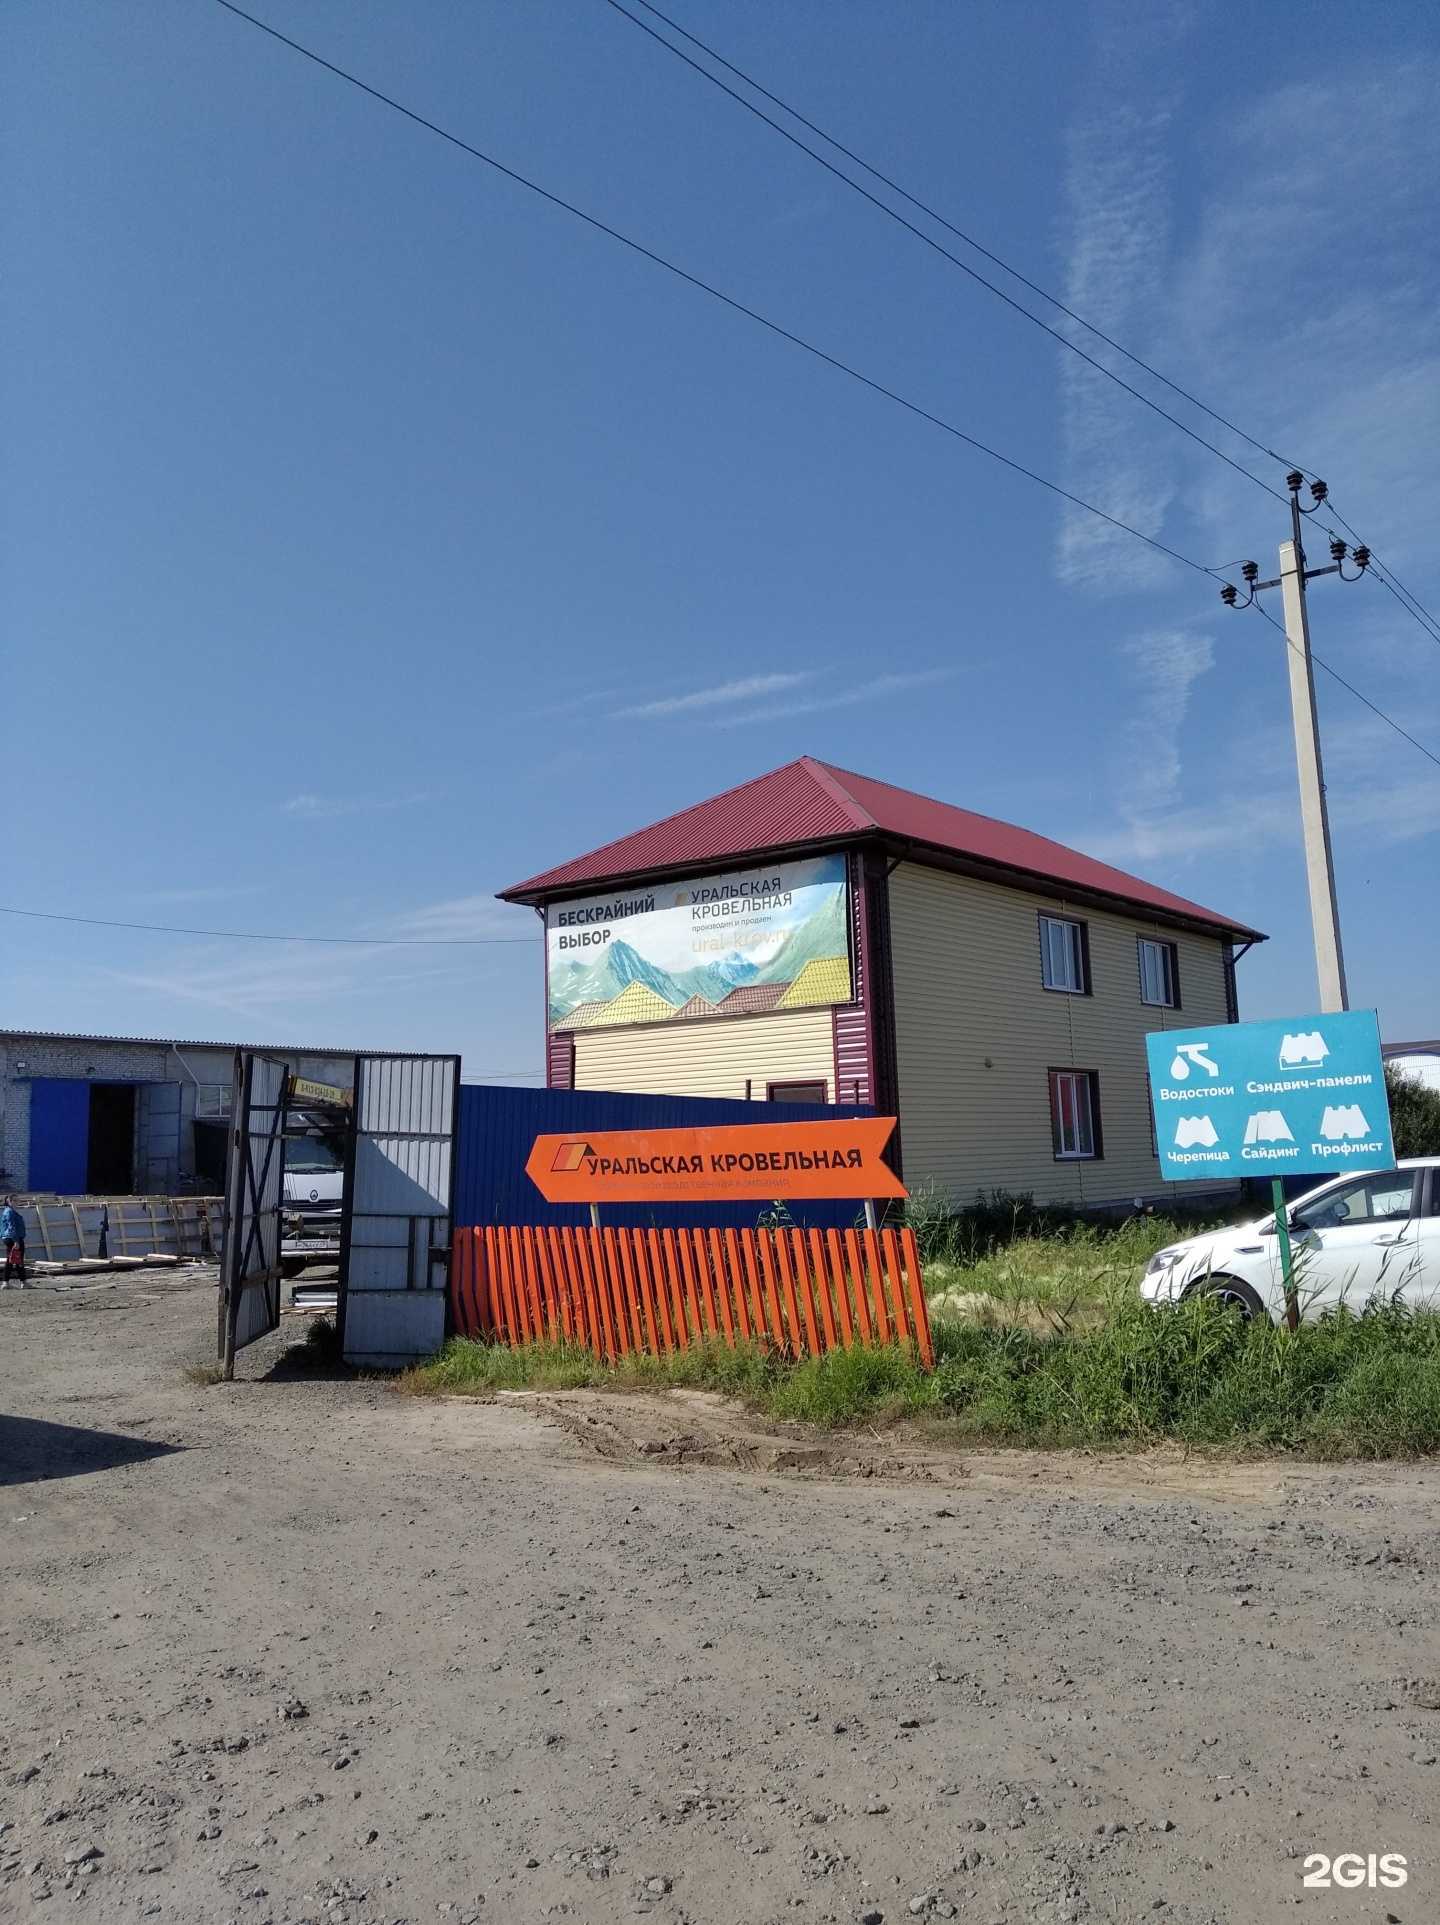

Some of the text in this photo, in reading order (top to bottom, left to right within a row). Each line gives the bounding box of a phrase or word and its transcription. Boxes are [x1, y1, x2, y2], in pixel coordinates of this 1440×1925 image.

[691, 877, 781, 903] УРАЛЬСКАЯ
[558, 893, 655, 927] БЕСКРАЙНИЙ
[692, 892, 792, 920] КРОВЕЛЬНАЯ
[559, 929, 611, 950] ВЫБОР
[1160, 1073, 1372, 1102] Водостоки Сэндвич-панели
[587, 1148, 863, 1176] УРАЛЬСКАЯ КРОВЕЛЬНАЯ
[1167, 1141, 1383, 1165] Черепица Сайдинг Профлист
